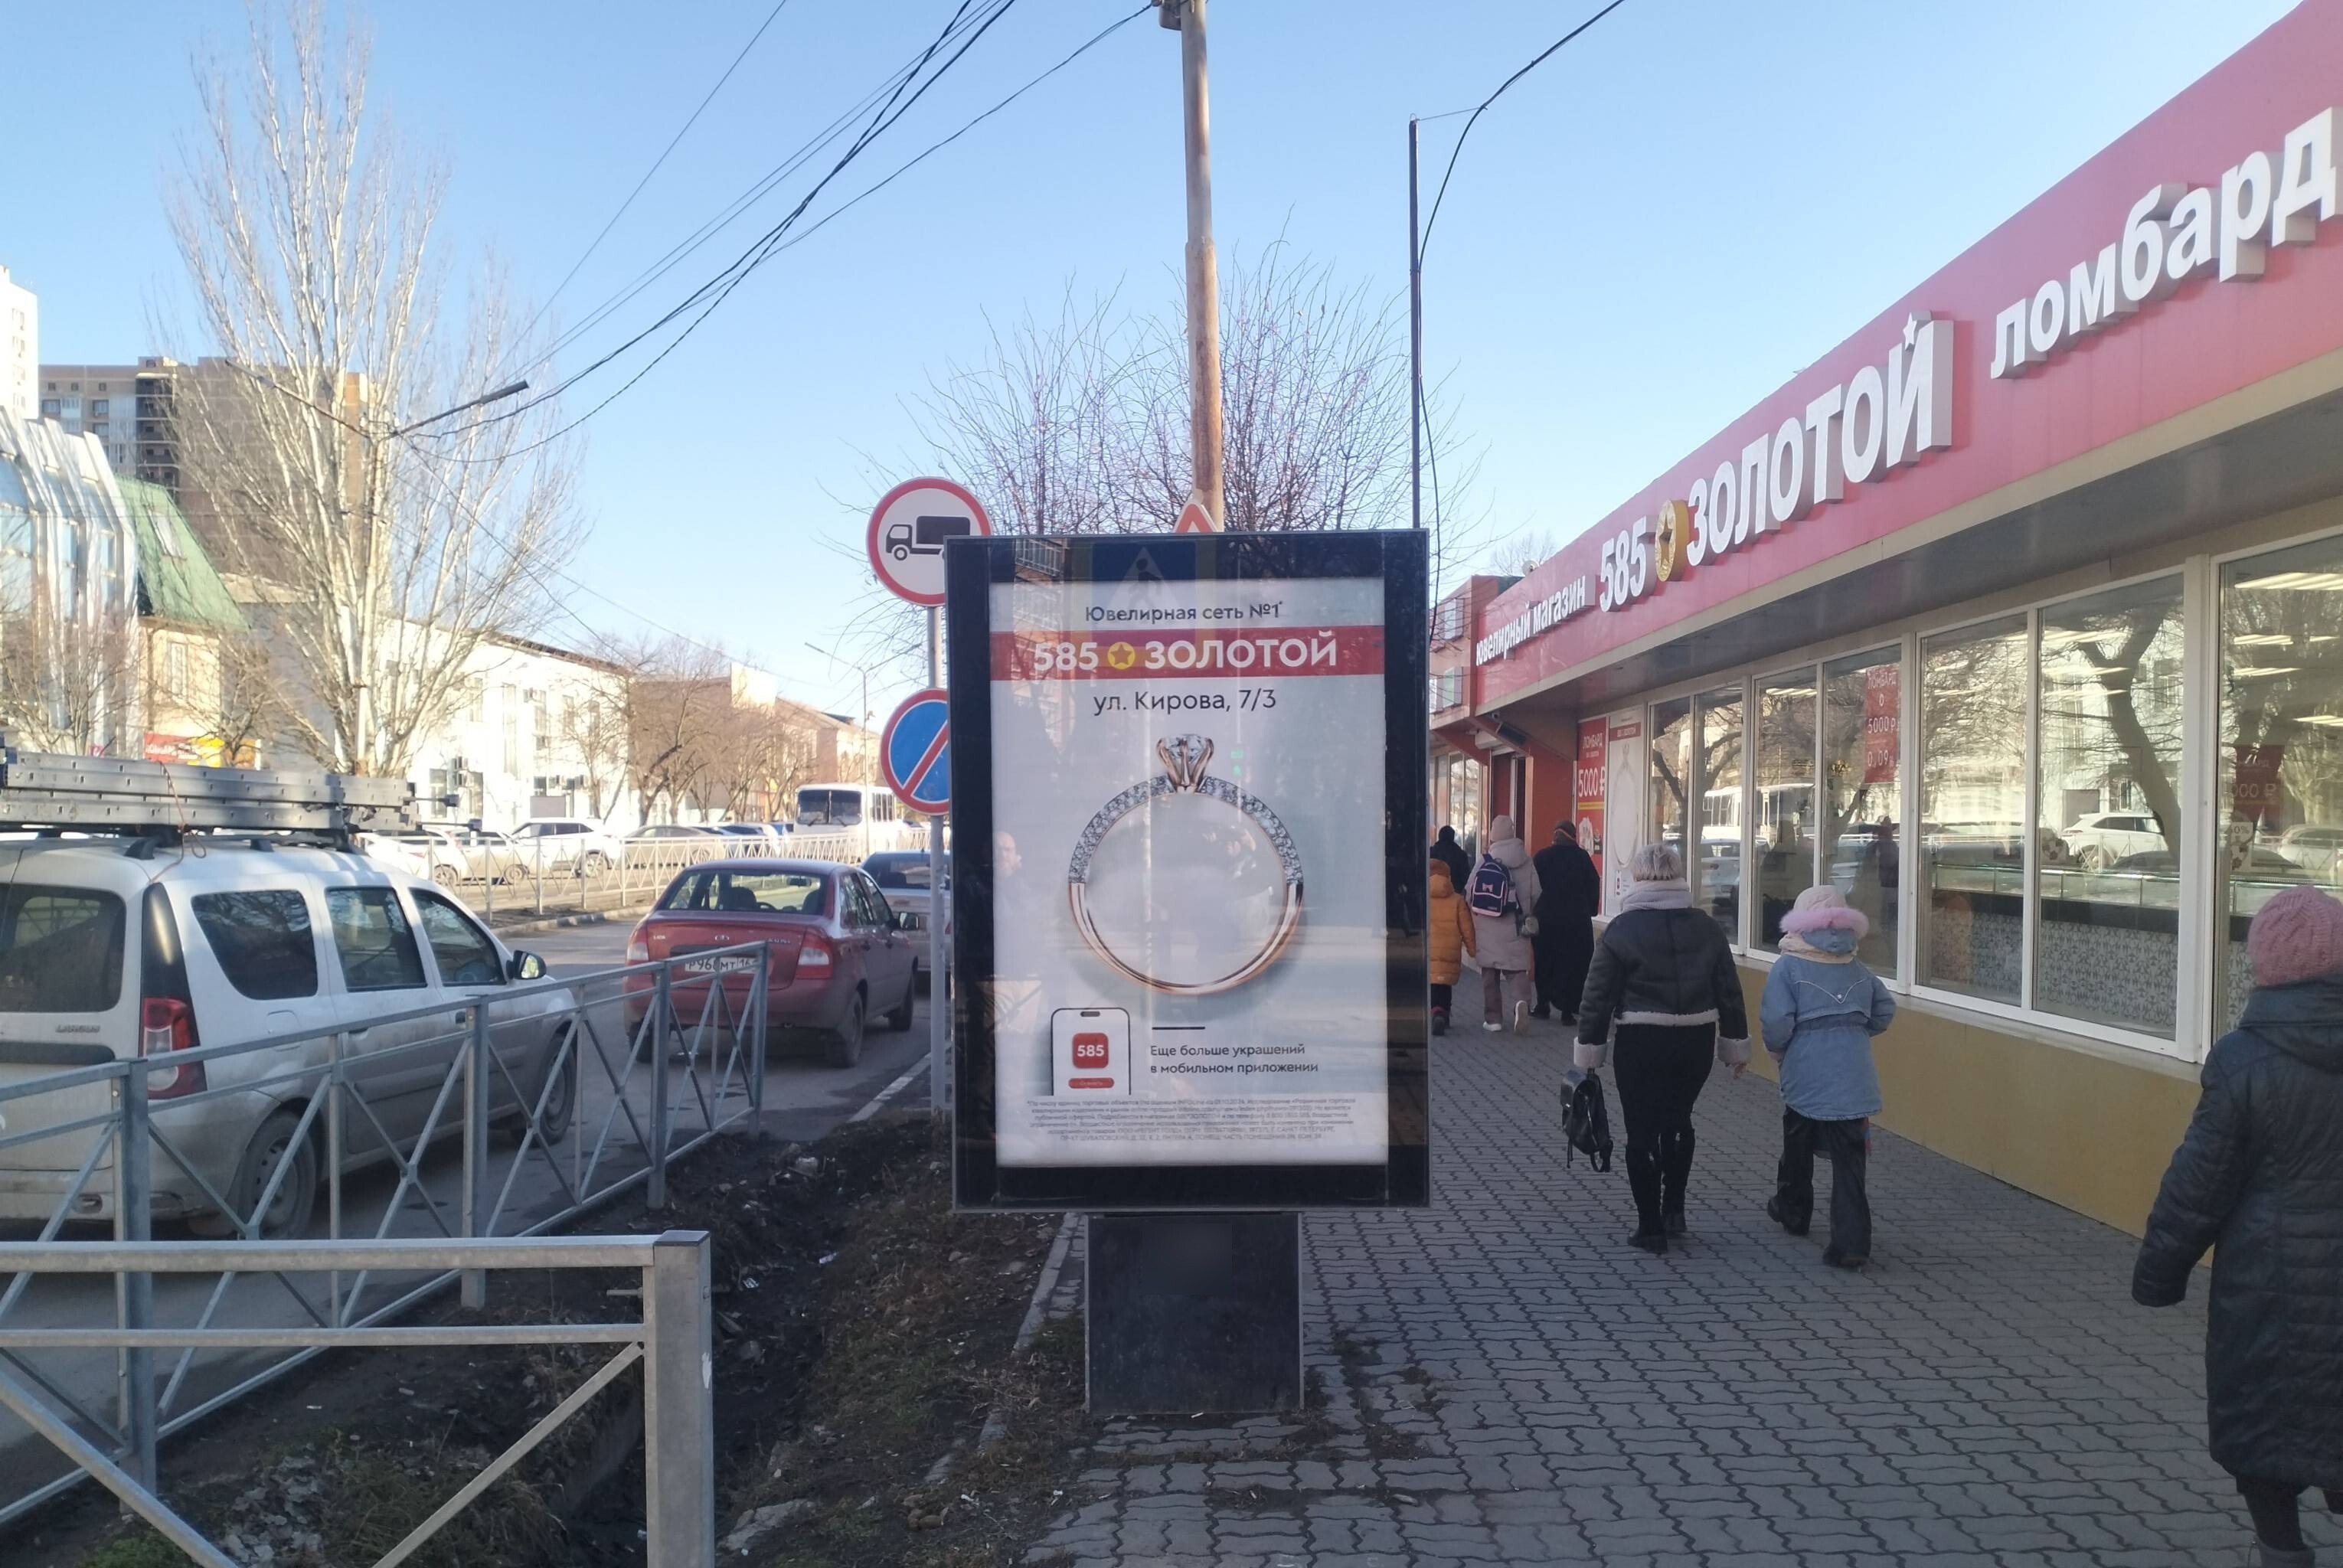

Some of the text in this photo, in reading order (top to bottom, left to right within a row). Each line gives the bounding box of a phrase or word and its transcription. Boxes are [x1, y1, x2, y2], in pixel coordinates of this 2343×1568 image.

[1991, 106, 2337, 380] ломбард
[1600, 312, 1937, 612] 585 ЗОЛОТОЙ
[1085, 606, 1196, 625] Ювелирная
[1202, 607, 1244, 620] сеть
[1476, 575, 1587, 666] ювелирный магазин
[1033, 630, 1338, 671] 585 ЗОЛОТОЙ
[1093, 688, 1276, 716] ул. Кирова, 7/3
[1868, 716, 1889, 733] 5000
[1578, 766, 1598, 798] 5000
[1077, 1044, 1105, 1057] 585
[1150, 1044, 1305, 1057] Еще больше украшений
[1150, 1063, 1319, 1075] в мобильном приложении
